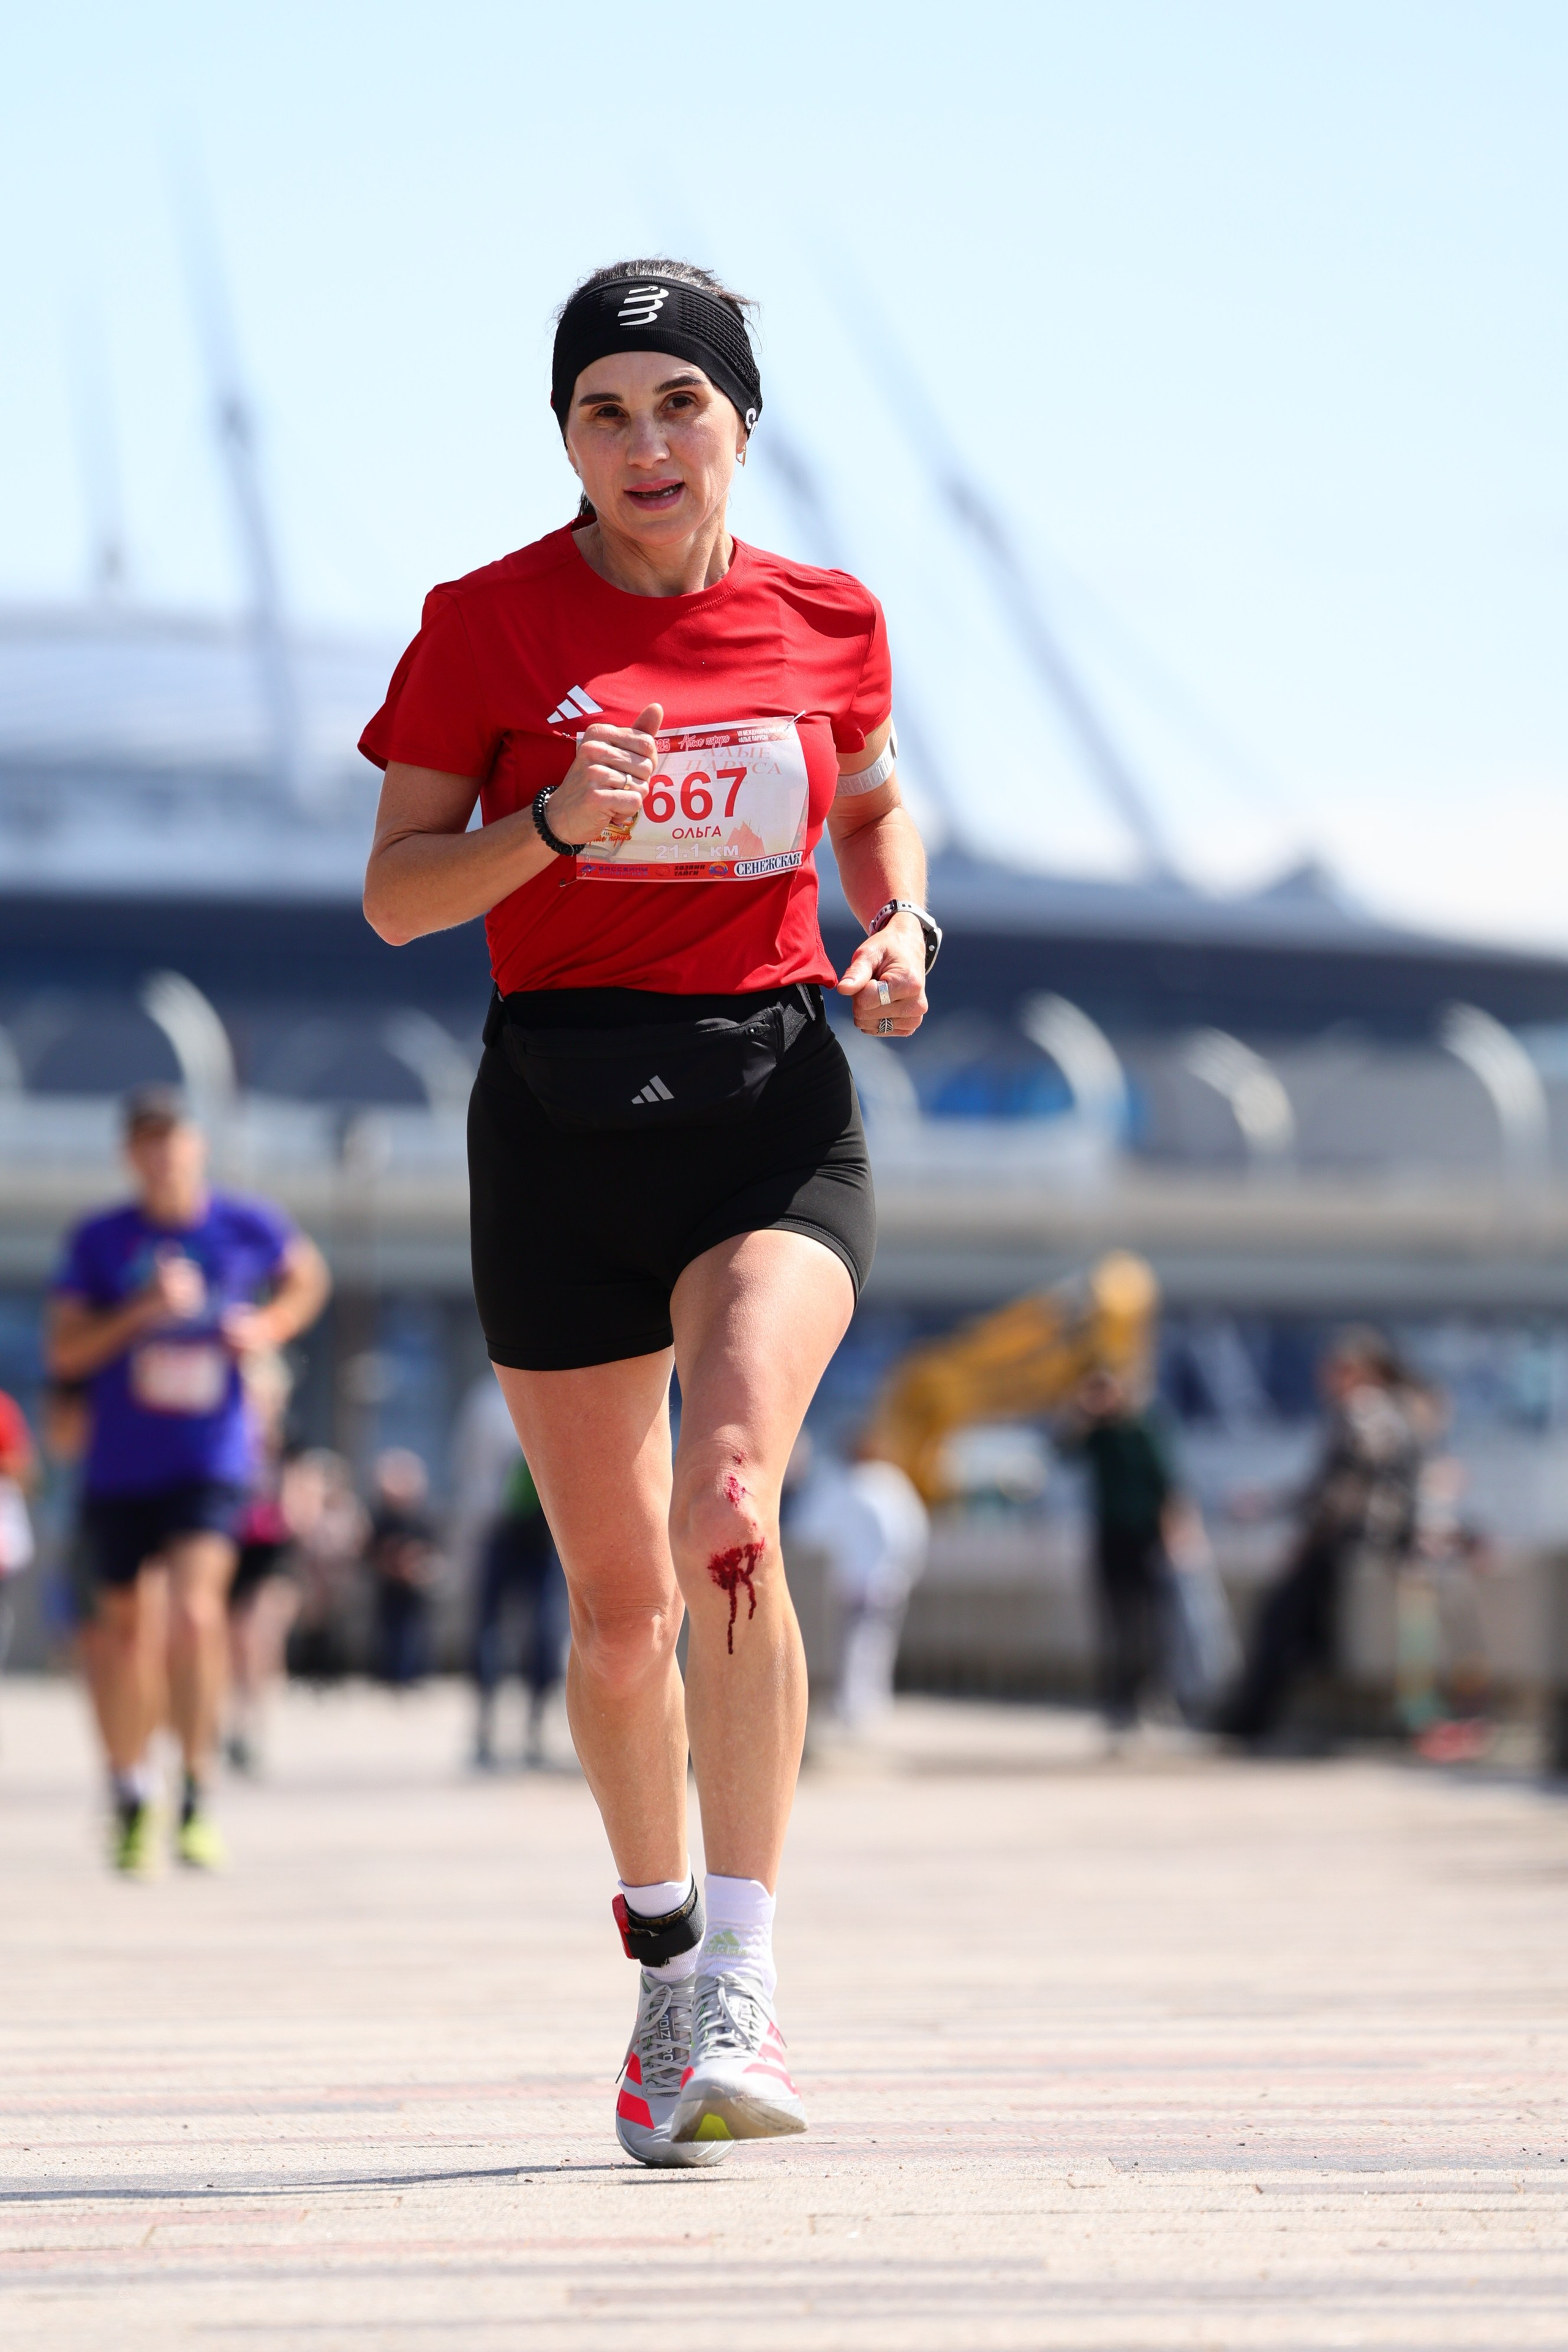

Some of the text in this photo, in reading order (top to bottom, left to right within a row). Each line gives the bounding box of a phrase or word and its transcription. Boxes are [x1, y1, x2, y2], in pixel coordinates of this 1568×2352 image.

[655, 738, 671, 752] 25
[702, 745, 772, 760] АЛЫЕ
[643, 766, 747, 823] 667
[672, 826, 722, 840] ОЛЬГА
[655, 843, 699, 859] 21.1
[736, 853, 801, 876] СЕНЕЖСКАЯ
[659, 2013, 674, 2062] ADIZRO
